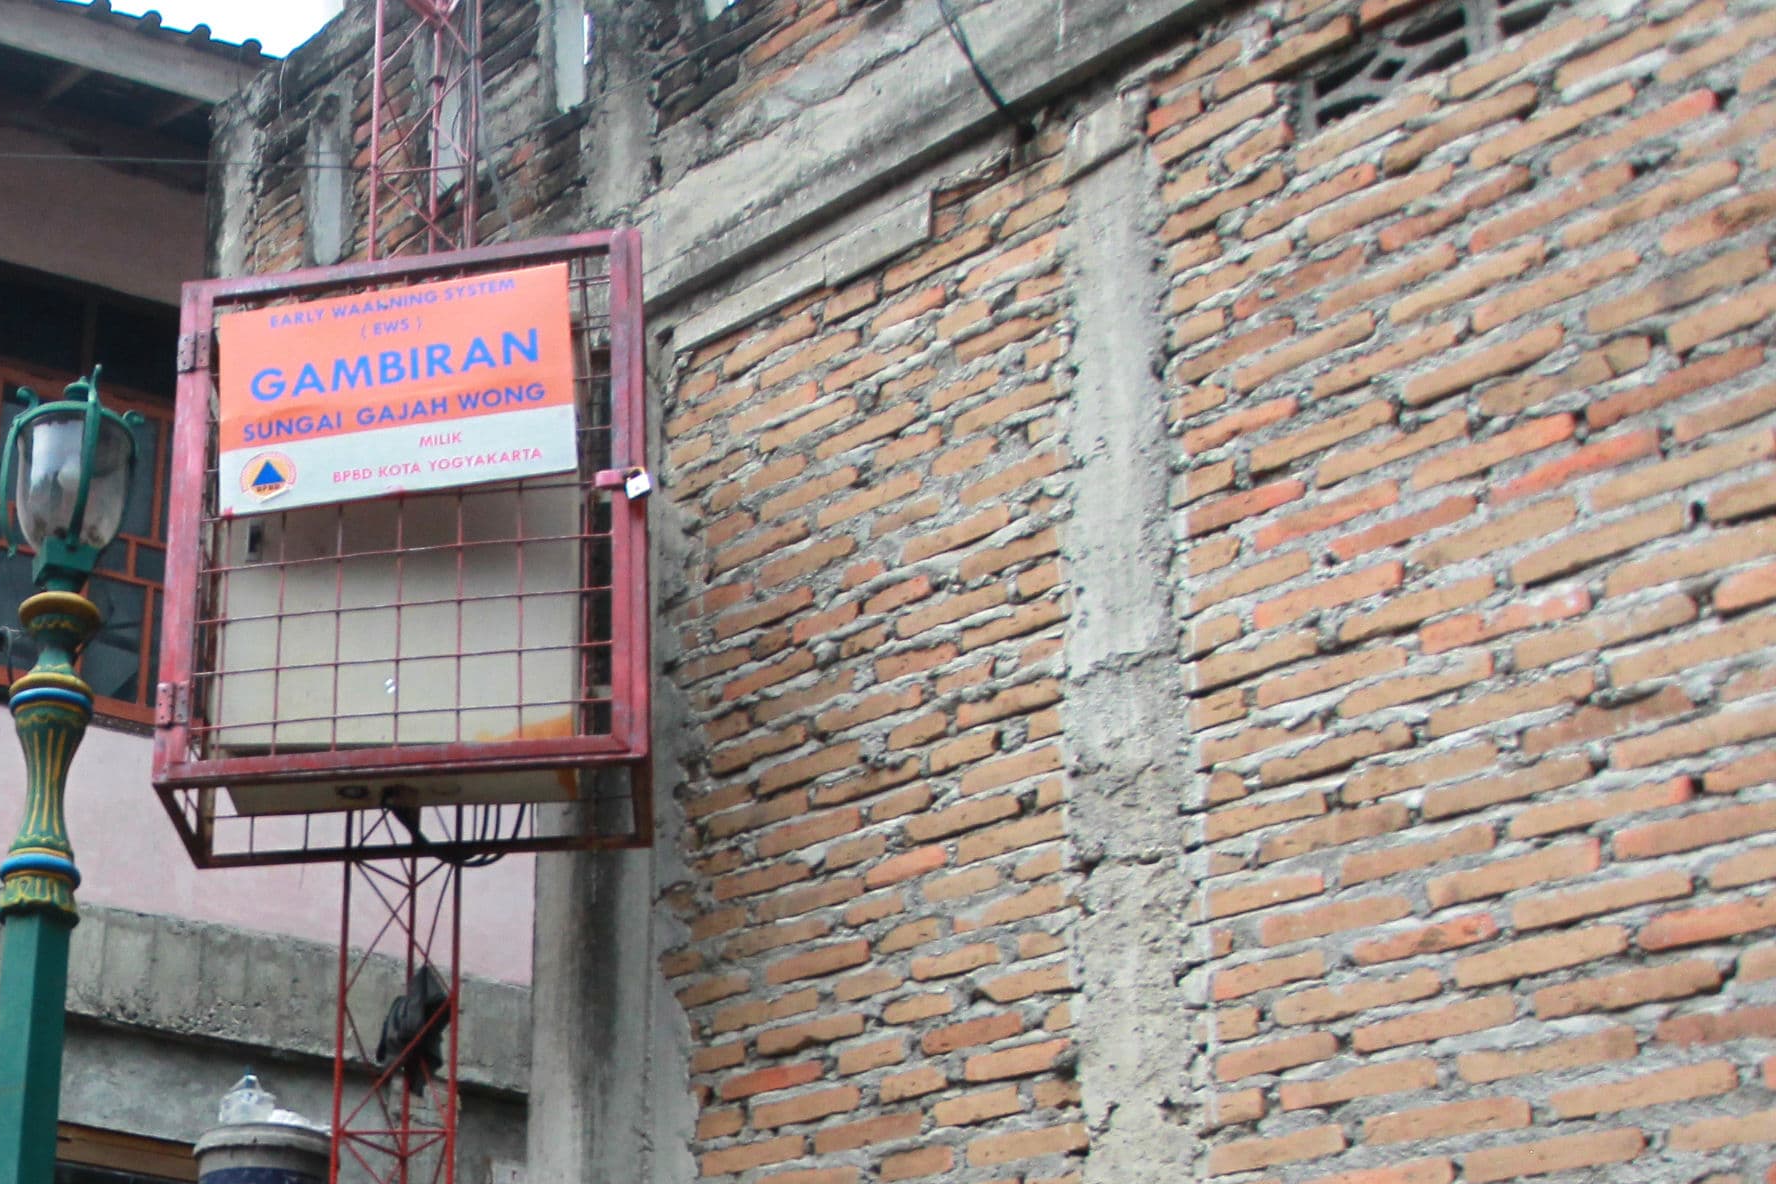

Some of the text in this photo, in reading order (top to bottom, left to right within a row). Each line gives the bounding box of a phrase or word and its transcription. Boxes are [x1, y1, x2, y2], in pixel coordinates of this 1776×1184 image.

[270, 308, 326, 329] EARLY
[444, 278, 516, 301] SYSTEM
[250, 328, 539, 401] GAMBIRAN
[242, 383, 545, 443] SUNGAI GAJAH WONG
[419, 431, 463, 448] MILIK
[332, 447, 543, 484] BPBD KOTA YOGYAKARTA
